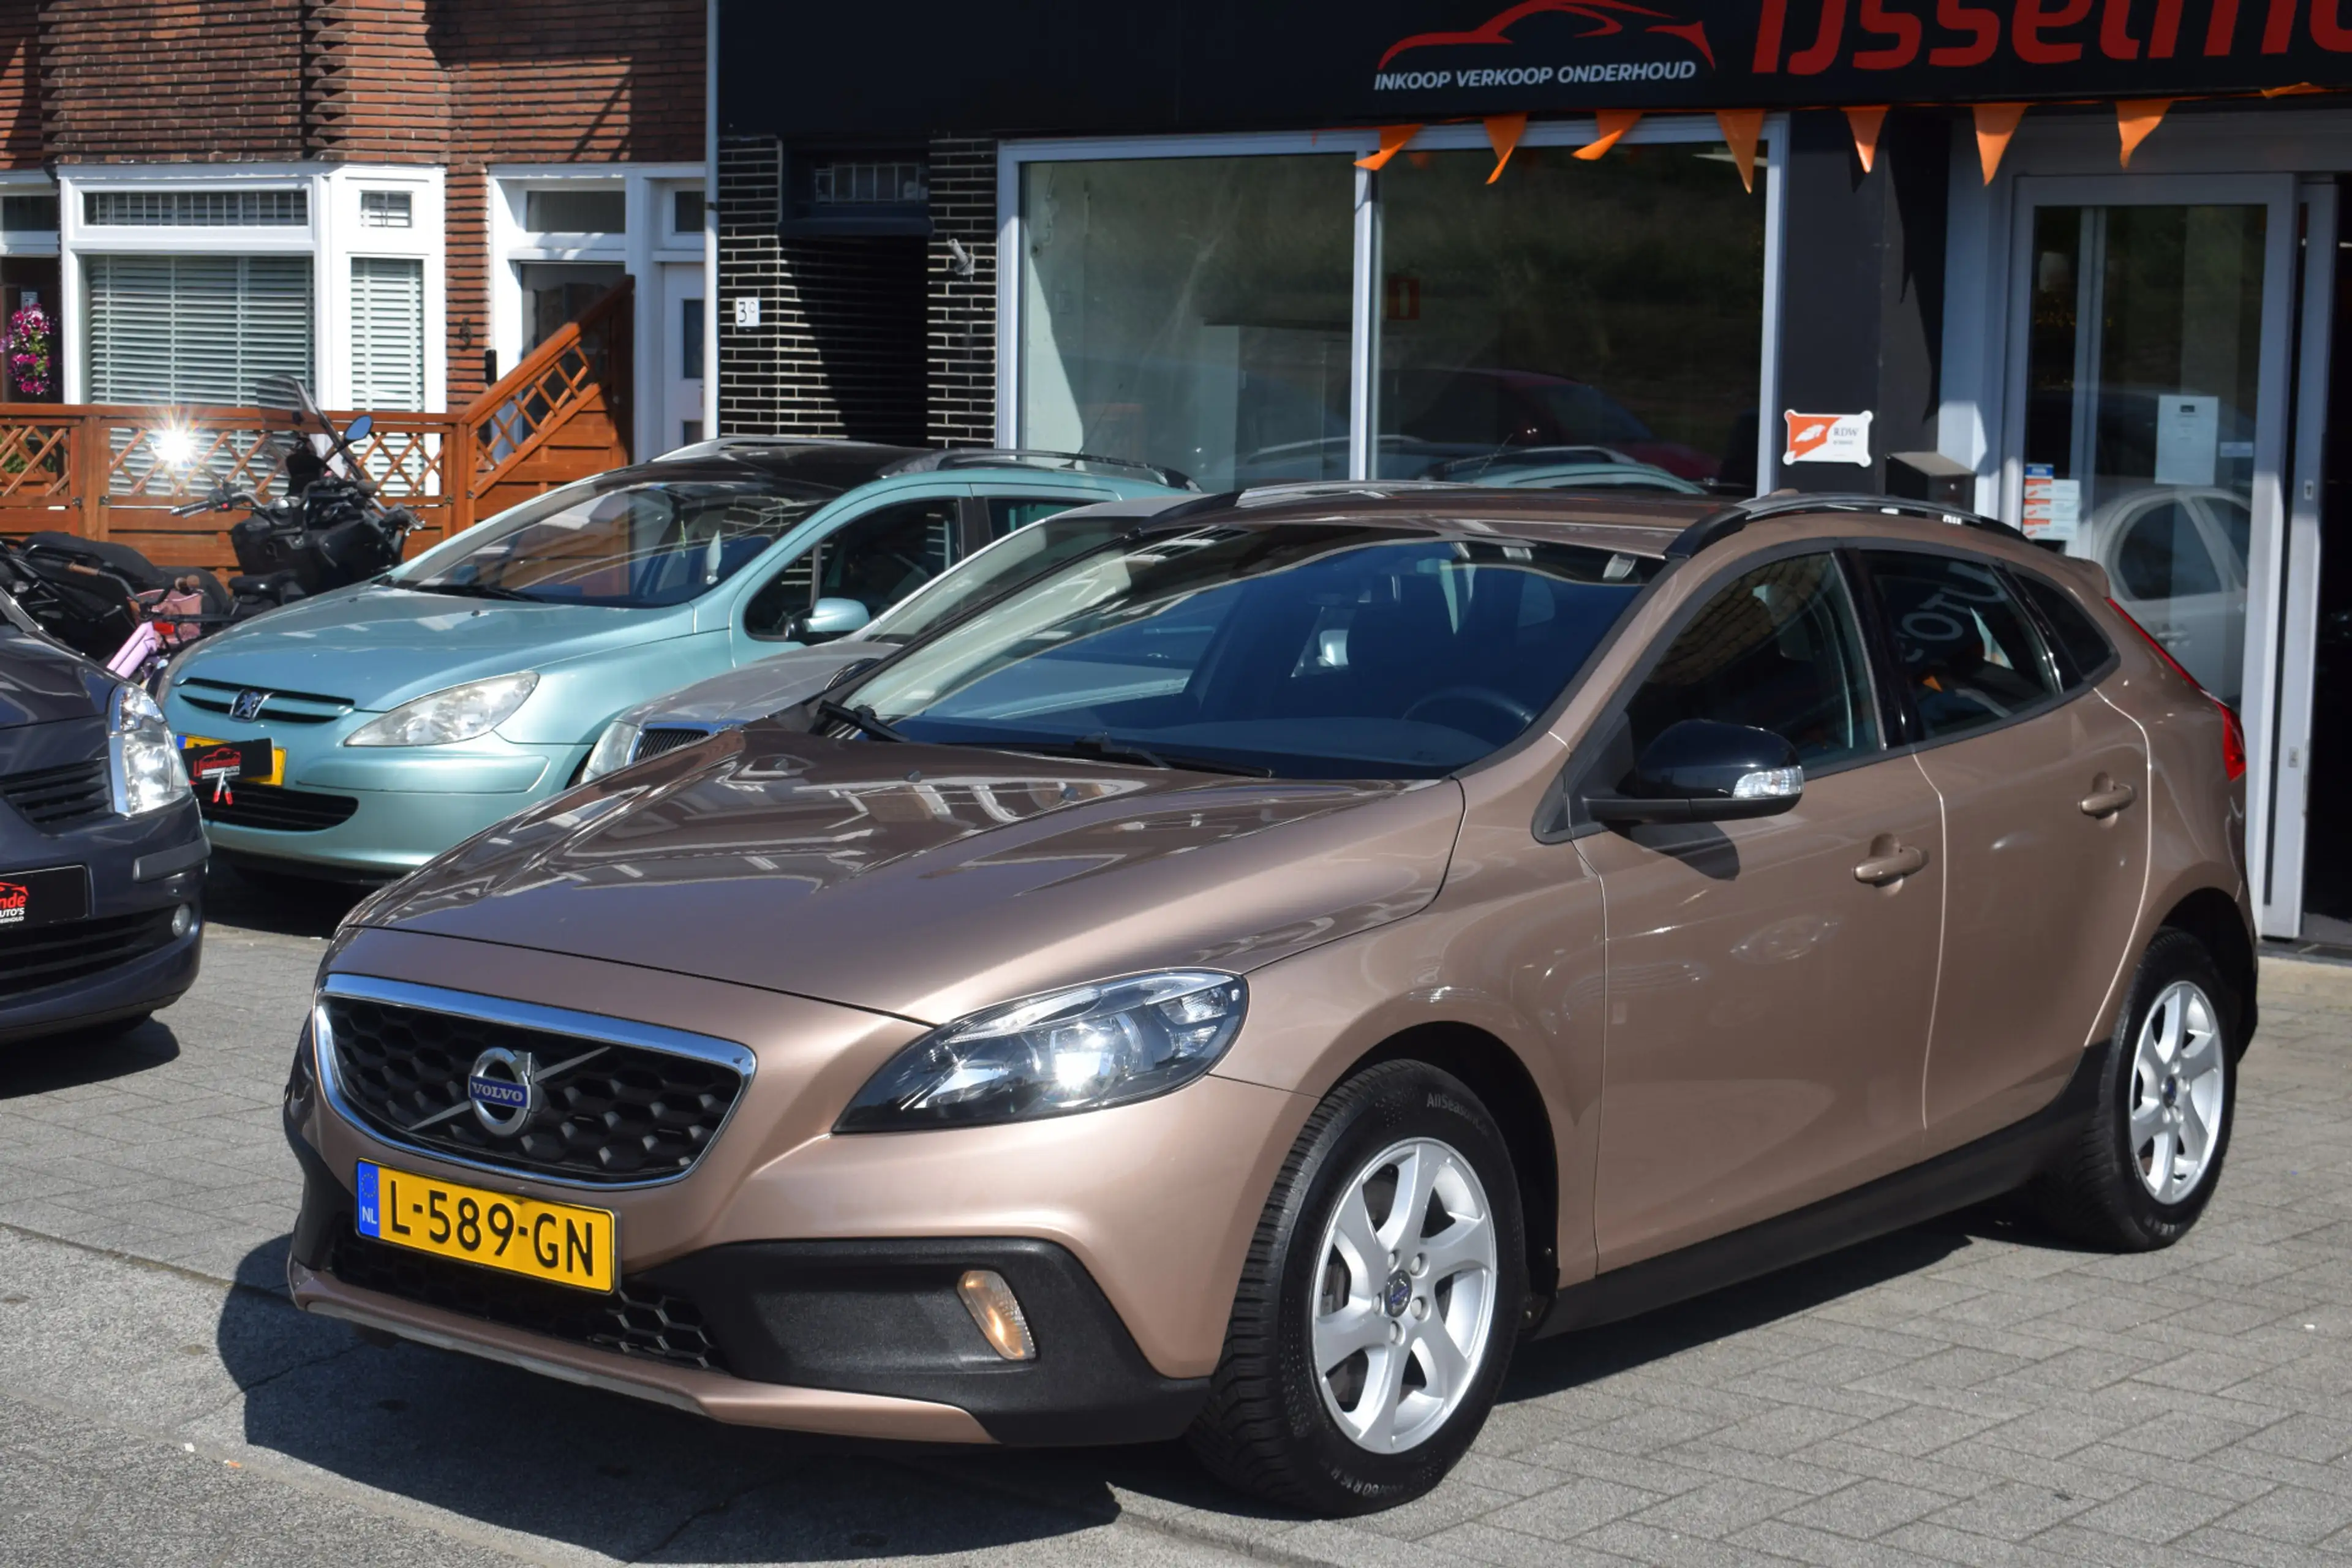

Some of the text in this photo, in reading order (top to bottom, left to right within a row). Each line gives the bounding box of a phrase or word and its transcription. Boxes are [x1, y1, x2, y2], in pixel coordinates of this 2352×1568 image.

[1373, 61, 1696, 91] INKOOP VERKOOP ONDERHOUD
[1833, 427, 1860, 437] RDW
[471, 1081, 524, 1102] VOLVO
[361, 1205, 378, 1225] NL
[390, 1180, 594, 1277] L-589-GN
